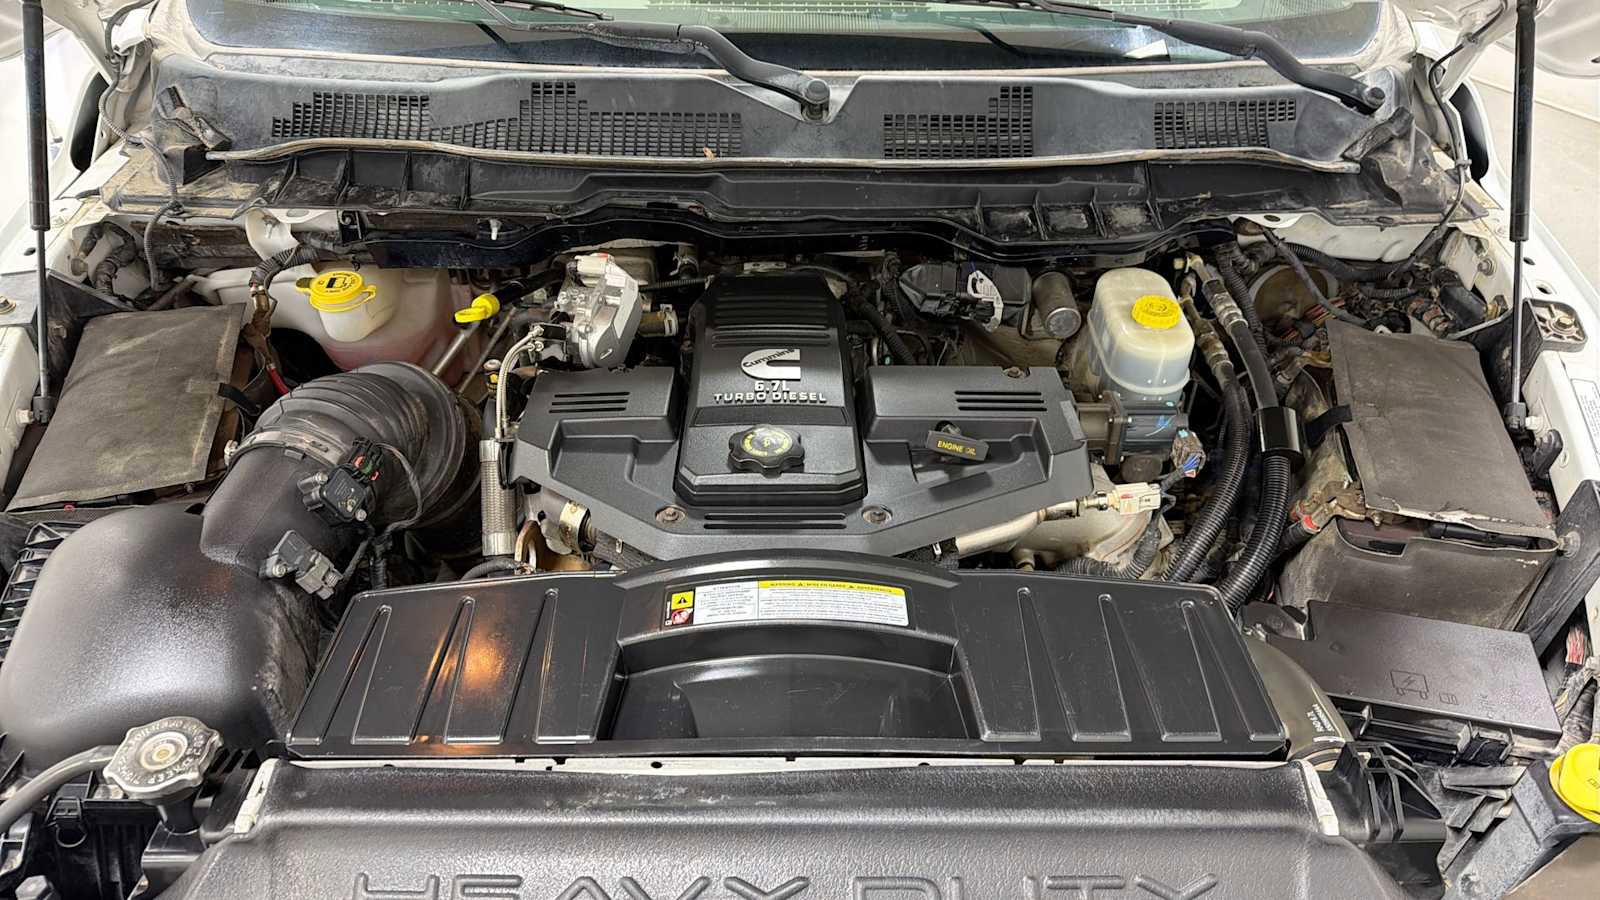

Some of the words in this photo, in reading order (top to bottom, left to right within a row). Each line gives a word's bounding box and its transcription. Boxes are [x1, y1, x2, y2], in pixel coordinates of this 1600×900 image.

[742, 347, 795, 368] Cummins
[754, 380, 790, 392] 6.7L
[713, 392, 766, 402] TURBO
[772, 392, 827, 402] DIESEL
[937, 440, 963, 453] ENGINE
